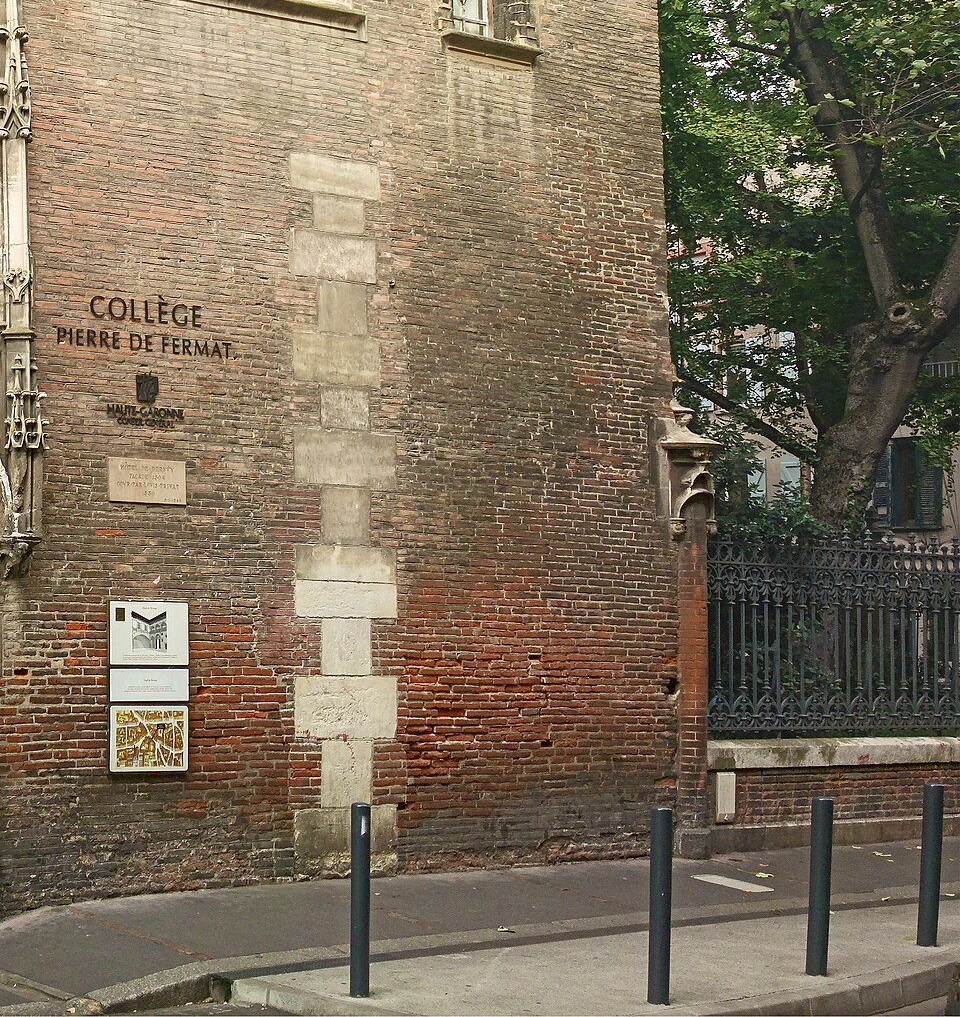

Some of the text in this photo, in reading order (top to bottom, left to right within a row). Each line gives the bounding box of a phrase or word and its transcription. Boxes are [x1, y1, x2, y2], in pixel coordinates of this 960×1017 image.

[90, 295, 202, 328] COLLÈGE
[56, 327, 232, 360] PIERRE DE FERMAT
